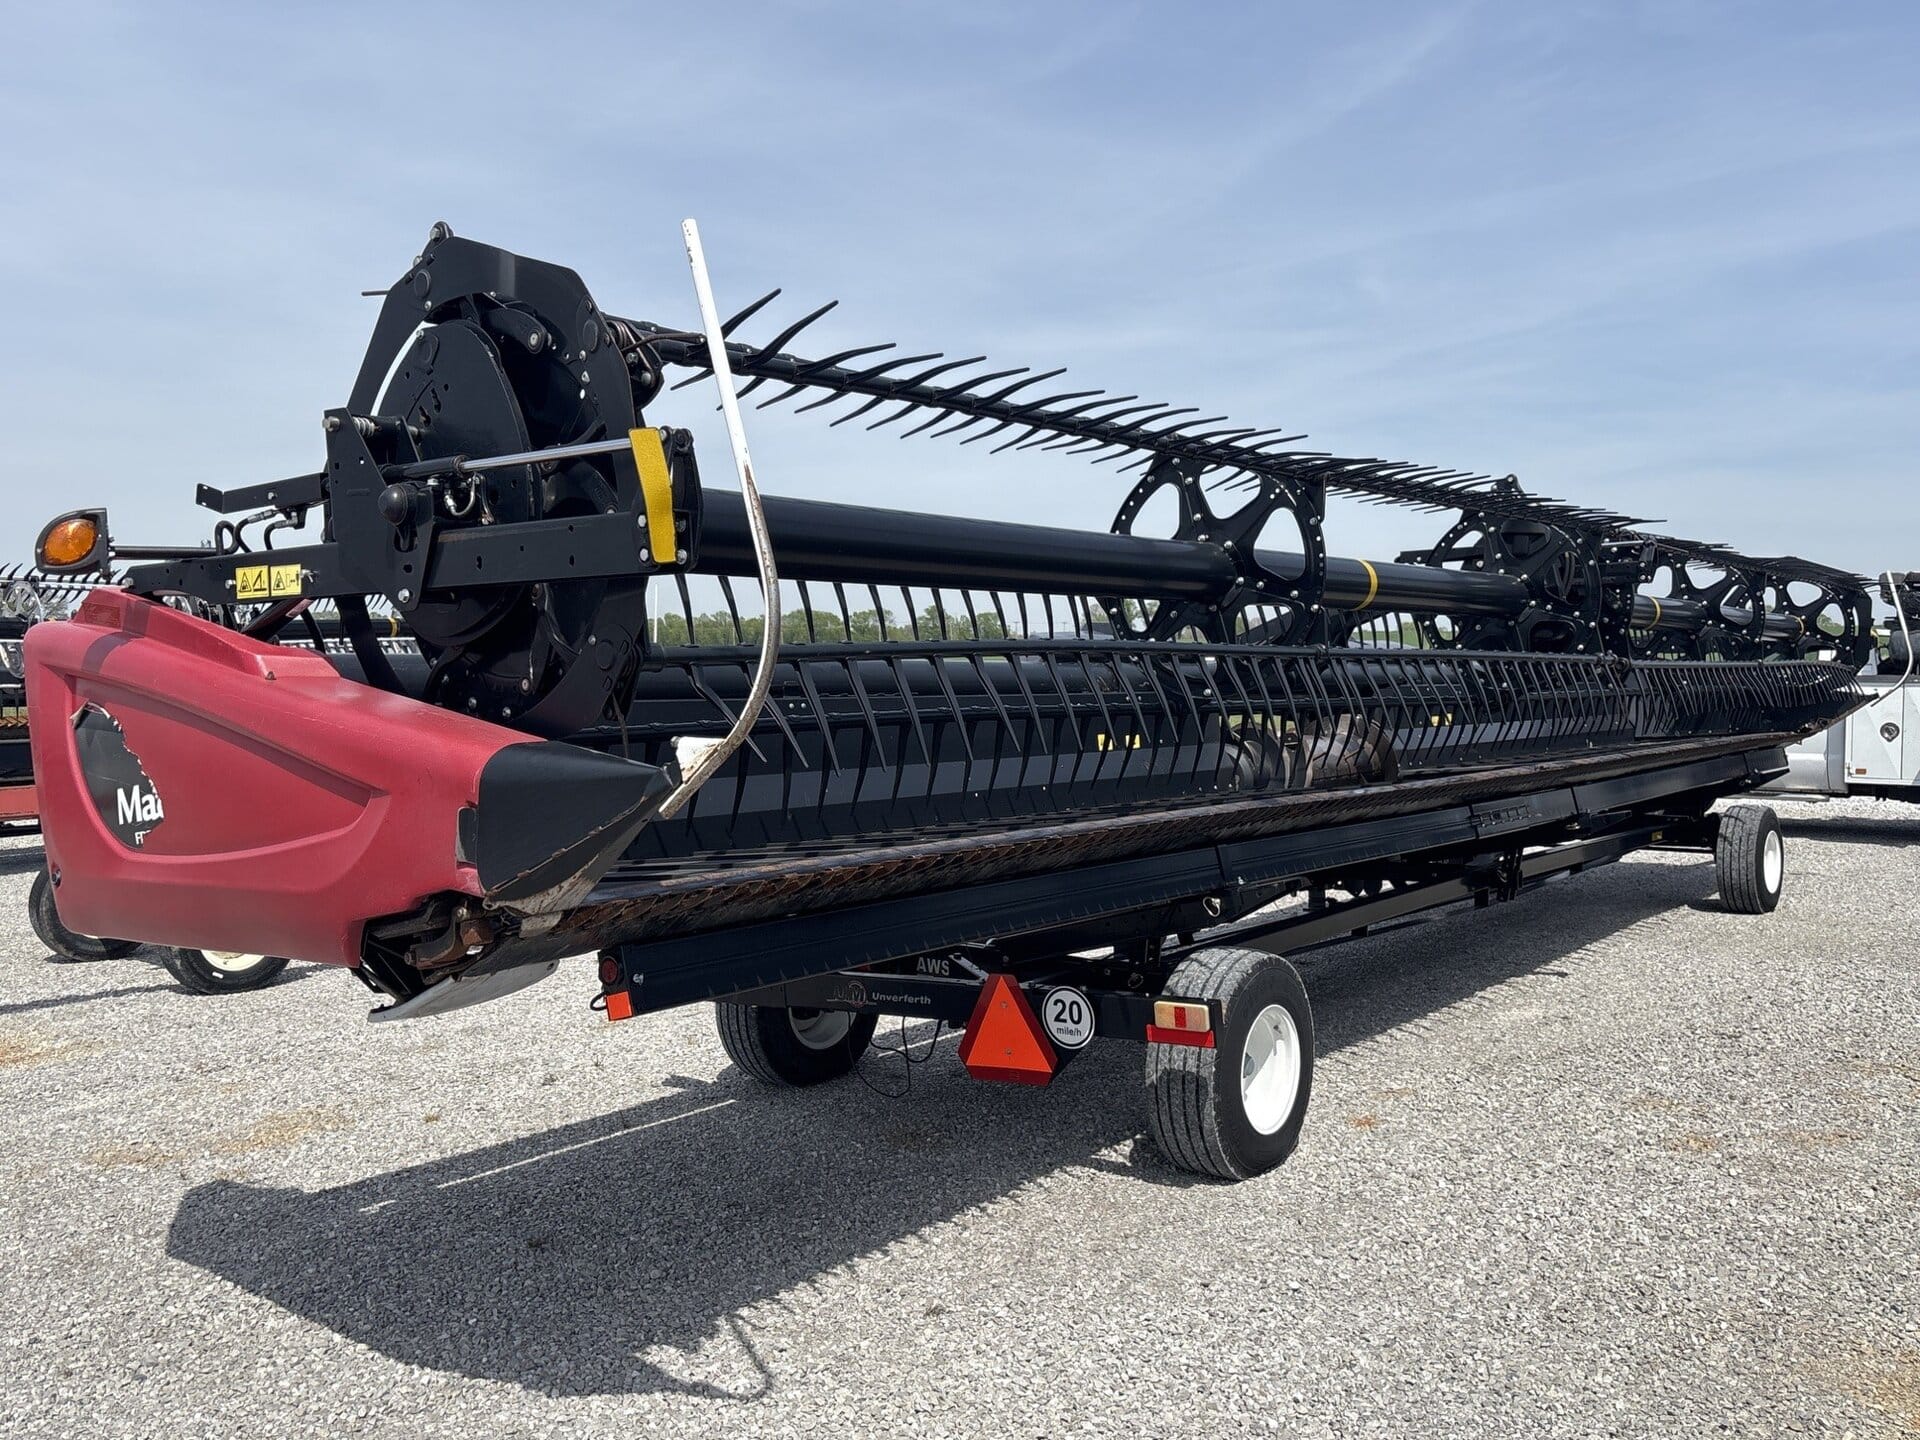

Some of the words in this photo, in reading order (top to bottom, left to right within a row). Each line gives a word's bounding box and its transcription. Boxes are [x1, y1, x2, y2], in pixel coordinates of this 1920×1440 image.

[915, 956, 950, 976] AWS
[871, 991, 932, 1005] Unverferth
[1053, 998, 1083, 1025] 20
[1056, 1027, 1082, 1037] mile/h
